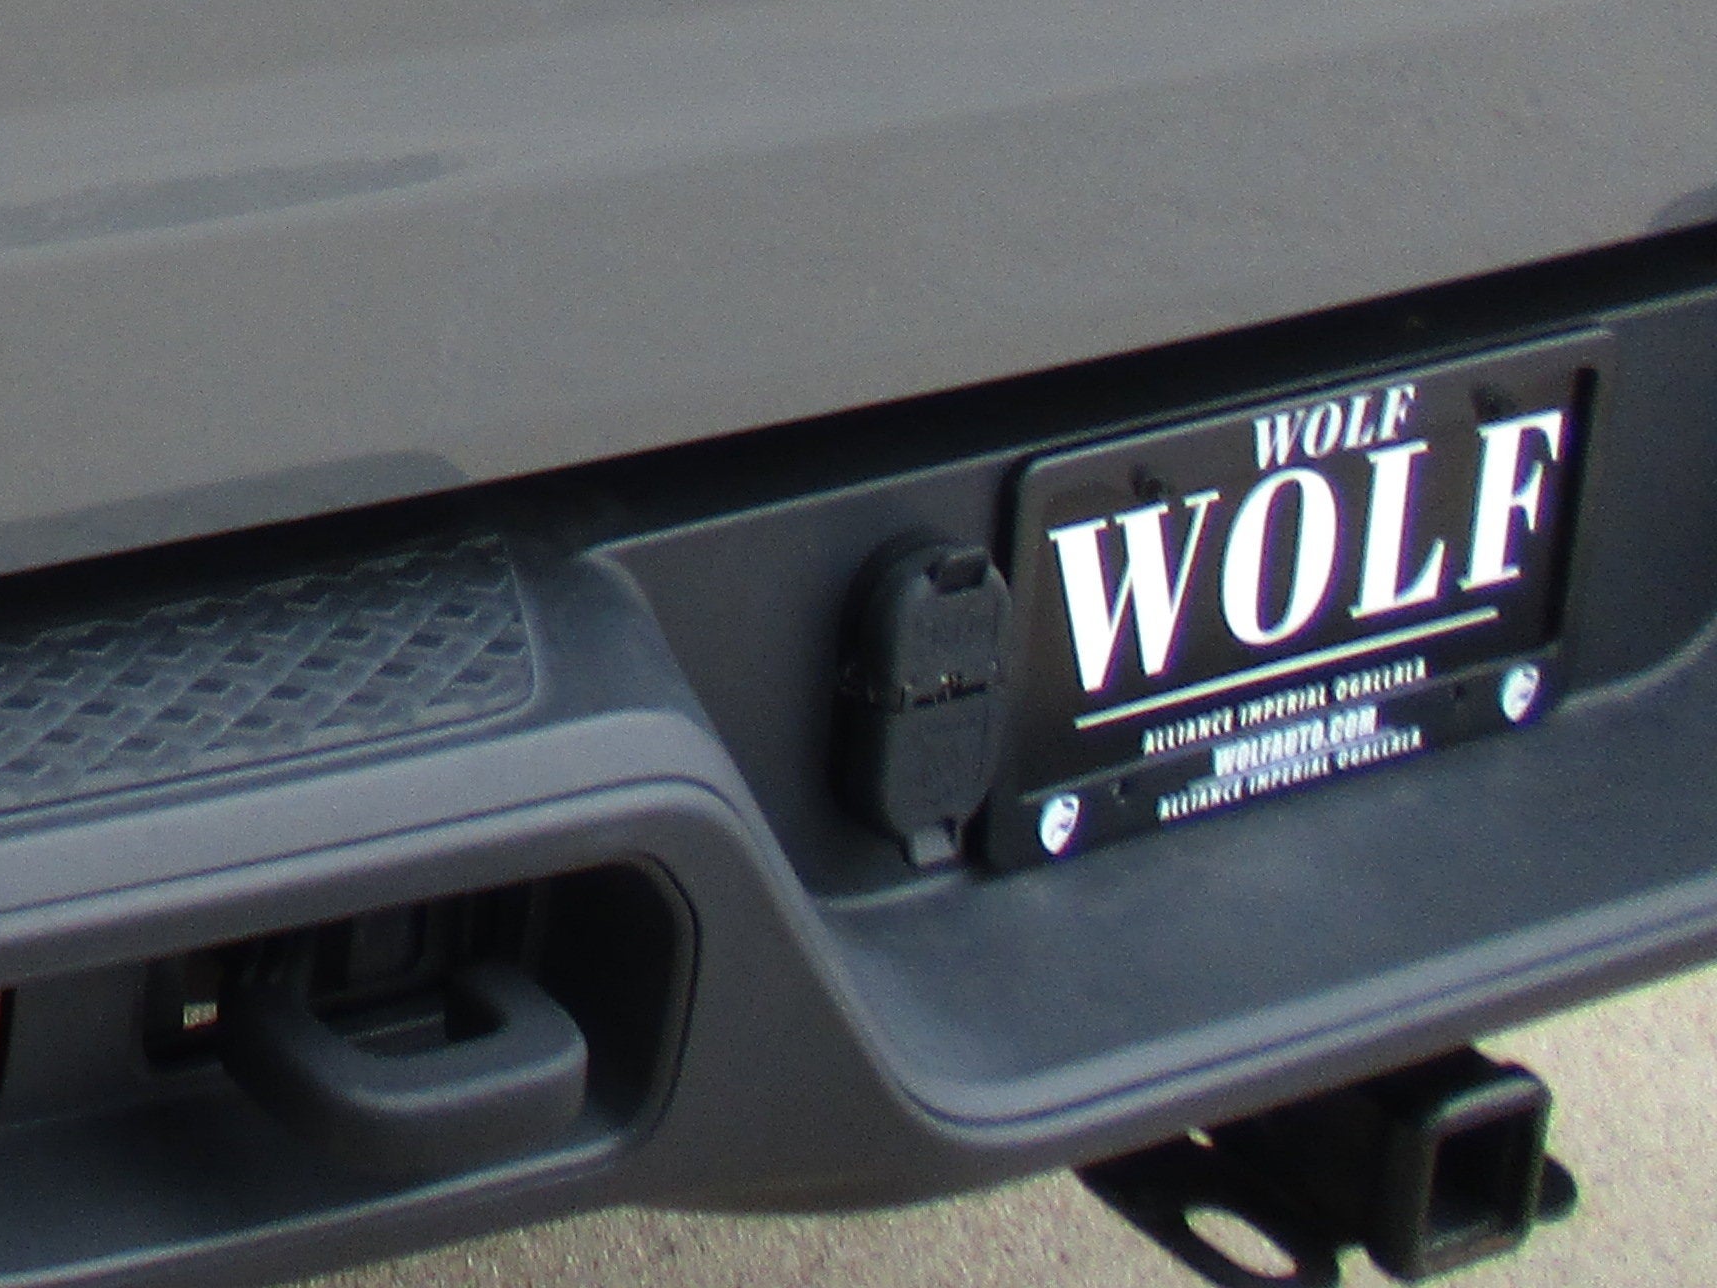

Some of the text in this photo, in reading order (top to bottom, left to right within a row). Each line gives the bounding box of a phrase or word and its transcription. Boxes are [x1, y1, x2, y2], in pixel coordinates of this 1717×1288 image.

[1253, 383, 1417, 470] WOLF
[1047, 409, 1563, 693] WOLF
[1142, 707, 1234, 756] ALLIANCE
[1238, 682, 1328, 727] IMPERIAL
